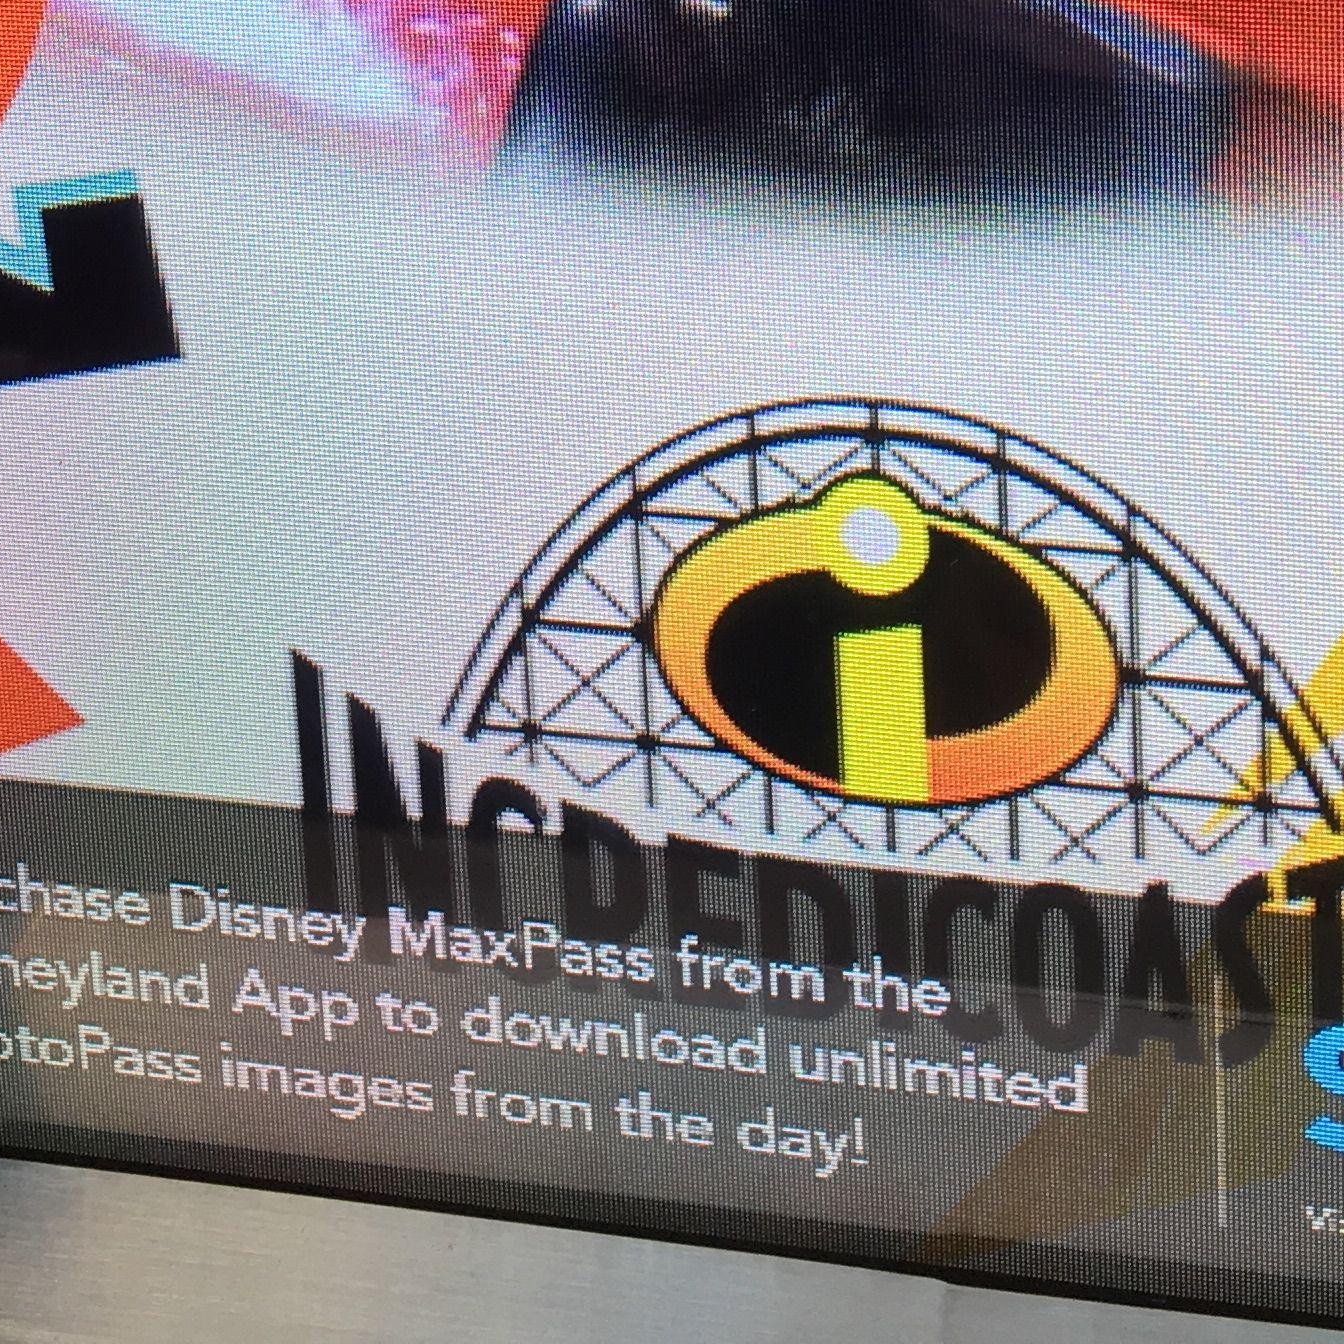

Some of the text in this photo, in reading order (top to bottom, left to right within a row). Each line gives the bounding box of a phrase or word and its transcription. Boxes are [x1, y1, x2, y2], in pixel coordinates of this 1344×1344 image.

[168, 882, 366, 962] Disney
[389, 906, 655, 984] MaxPass
[675, 933, 825, 1000] from
[842, 955, 951, 1015] the
[218, 1041, 432, 1119] images
[449, 1069, 592, 1130] from
[613, 1089, 714, 1146] the
[736, 1106, 869, 1178] day!
[231, 968, 356, 1041] App
[374, 991, 439, 1036] to
[460, 995, 767, 1074] download
[788, 1038, 1089, 1114] unlimited
